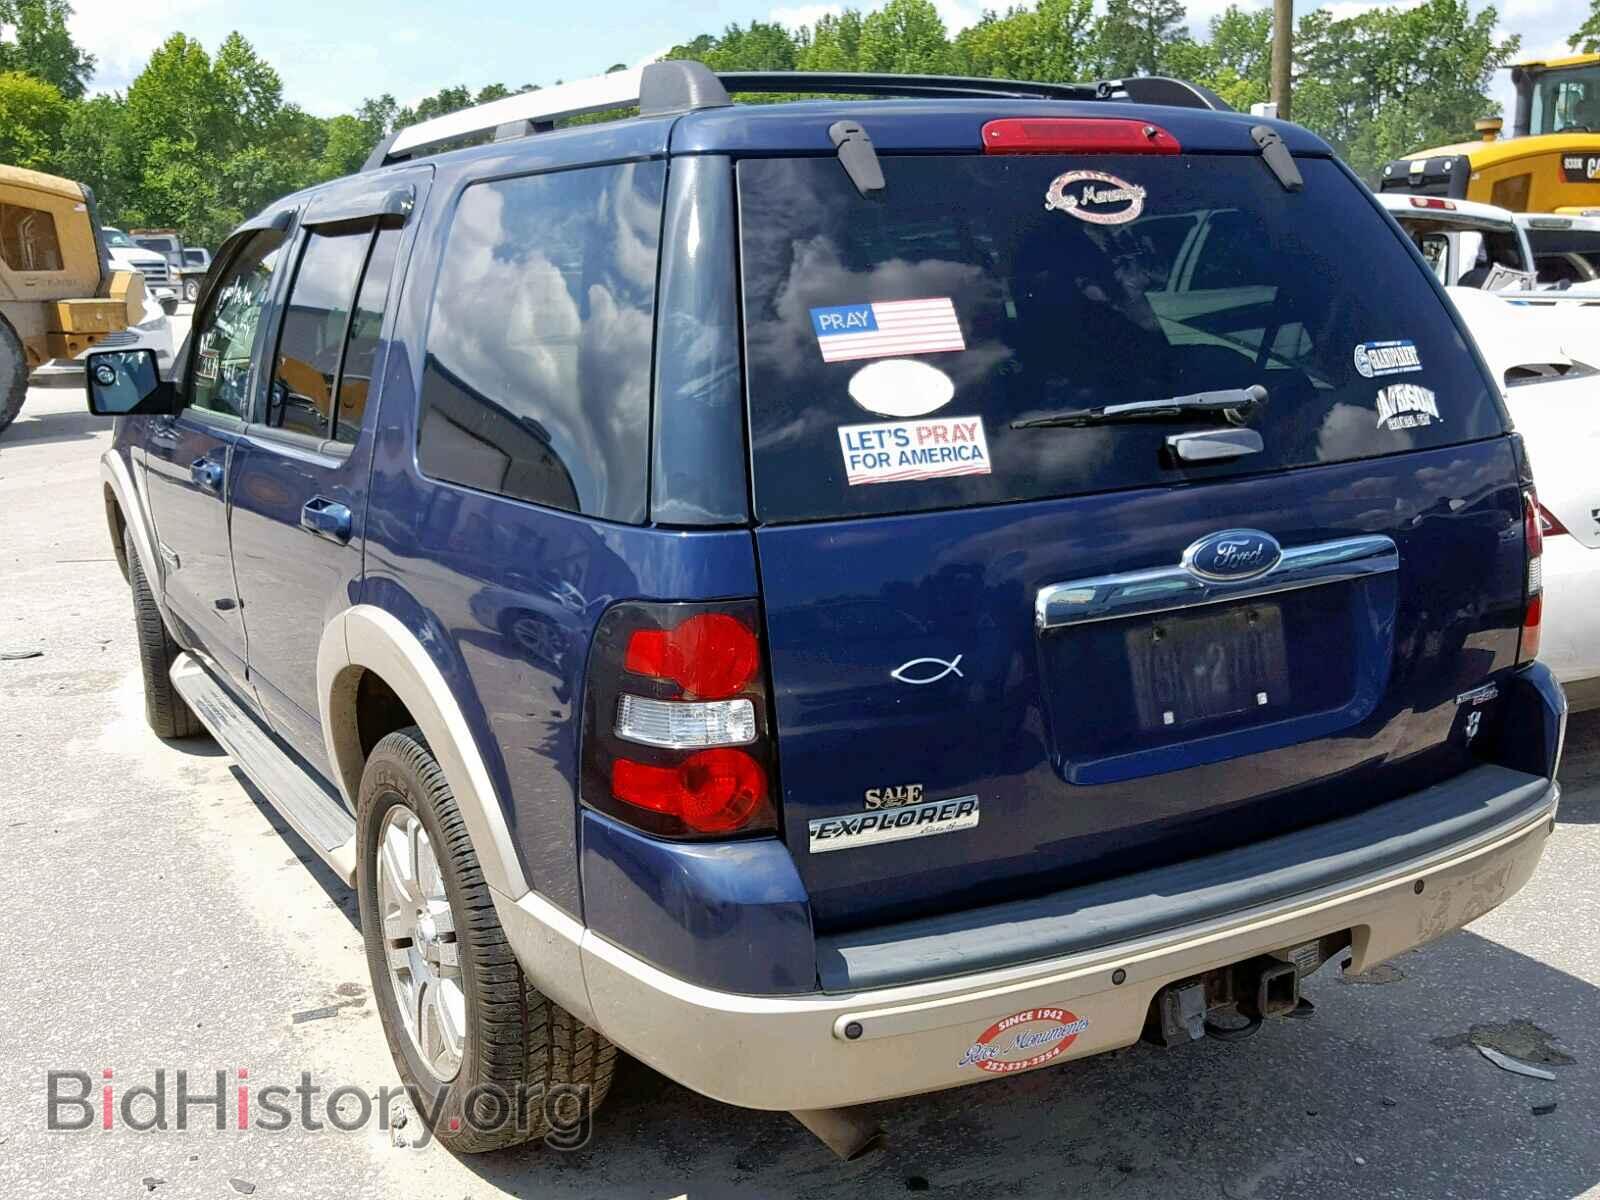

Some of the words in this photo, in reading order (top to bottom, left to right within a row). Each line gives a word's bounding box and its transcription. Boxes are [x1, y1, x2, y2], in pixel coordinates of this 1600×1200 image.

[819, 310, 868, 330] PRAY
[845, 428, 910, 451] LET'S
[916, 422, 977, 445] PRAY
[850, 452, 891, 470] FOR
[898, 445, 983, 466] AMERICA
[1214, 540, 1263, 569] Ford
[865, 784, 923, 810] SALE
[815, 801, 975, 840] EXPLORER
[998, 1011, 1034, 1031] SINCE
[1038, 1009, 1063, 1020] 1942
